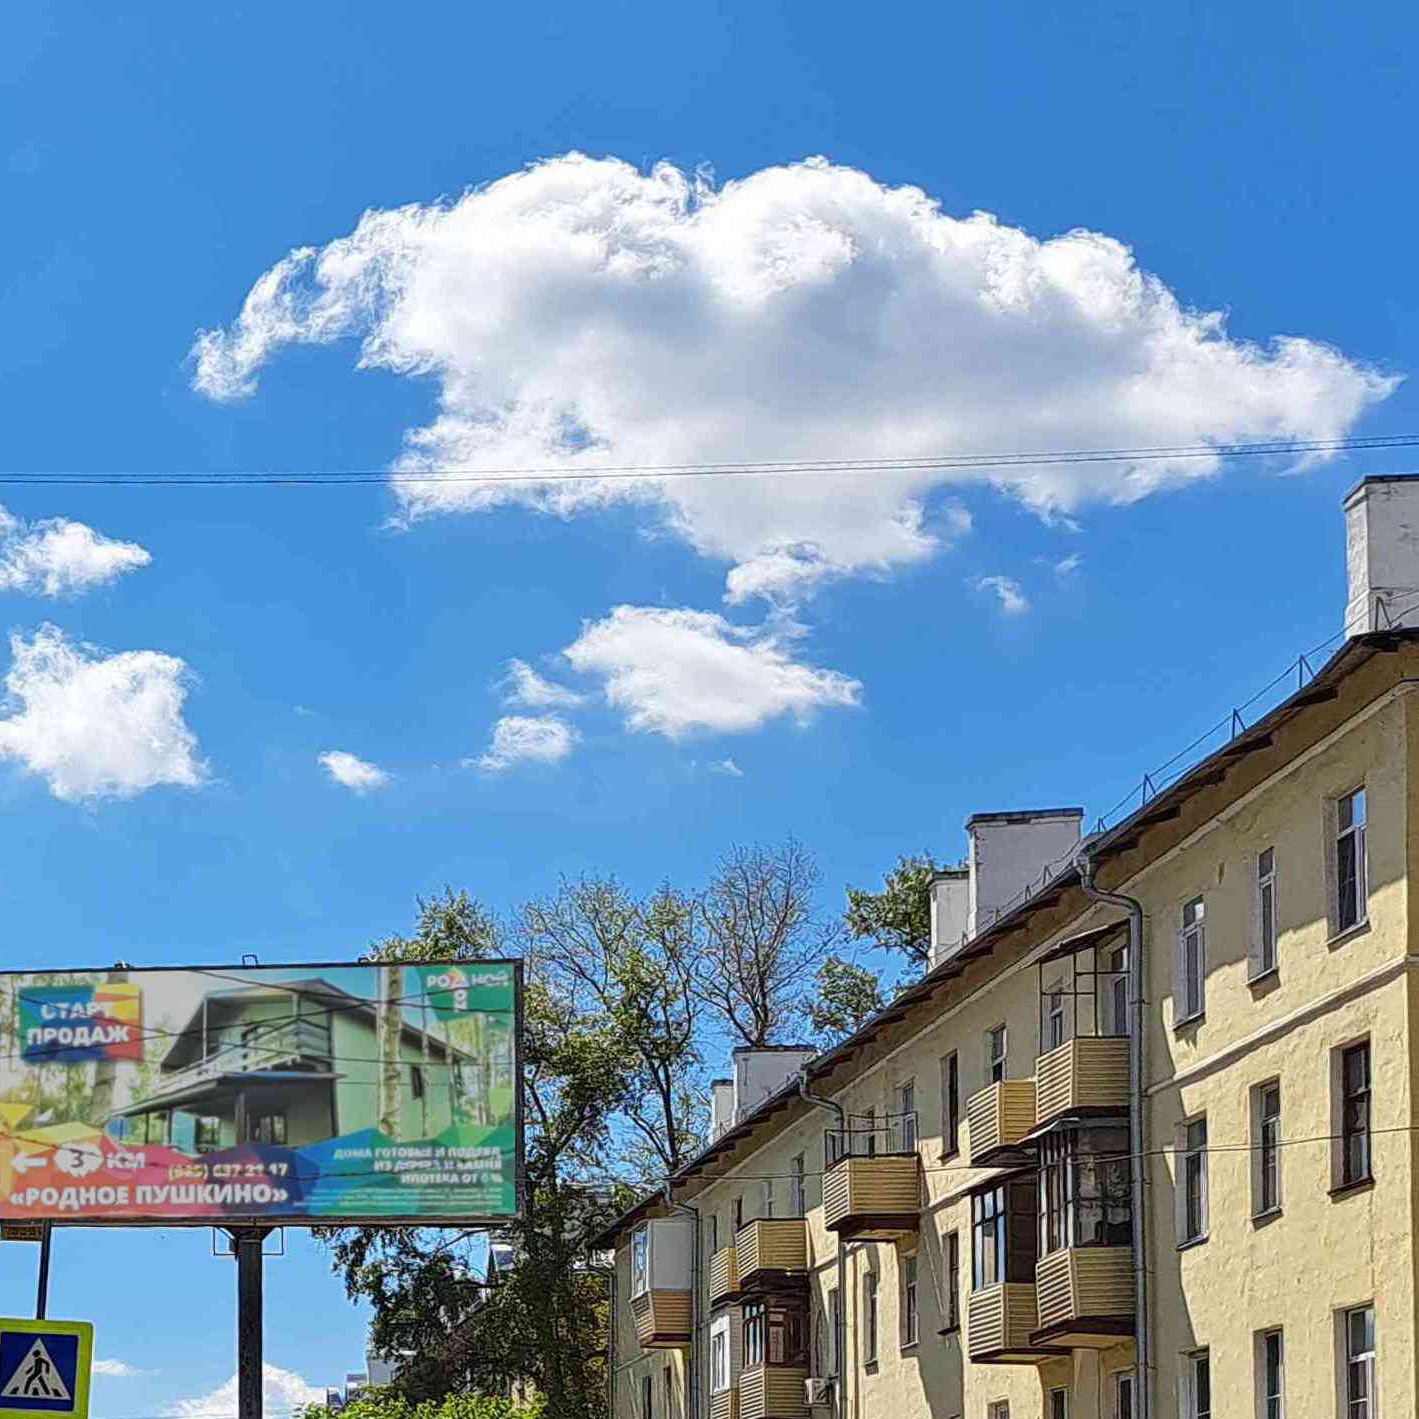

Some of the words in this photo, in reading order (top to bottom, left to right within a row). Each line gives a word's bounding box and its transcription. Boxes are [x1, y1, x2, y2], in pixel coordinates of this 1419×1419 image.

[41, 1001, 113, 1020] СТАРТ
[27, 1025, 130, 1047] ПРОДАЖ
[73, 1151, 84, 1168] 3
[11, 1187, 129, 1211] «РОДНОЕ
[136, 1183, 289, 1205] ПУШКИНО»
